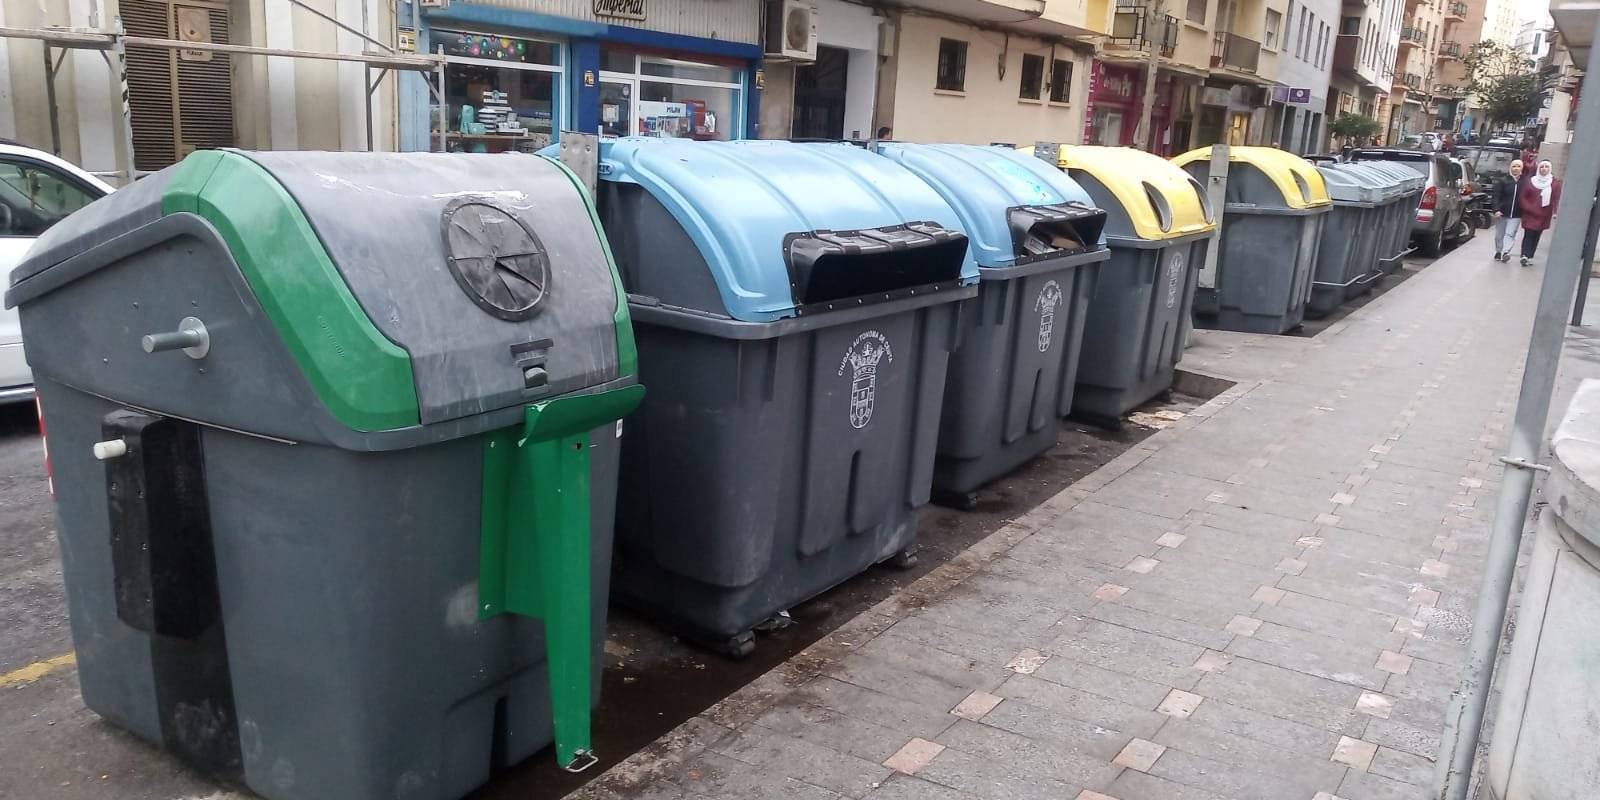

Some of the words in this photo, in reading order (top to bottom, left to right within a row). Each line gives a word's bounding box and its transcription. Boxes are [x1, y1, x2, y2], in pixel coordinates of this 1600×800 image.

[838, 346, 853, 376] CIUDAD
[878, 333, 886, 344] DE
[884, 341, 893, 364] CEUTA
